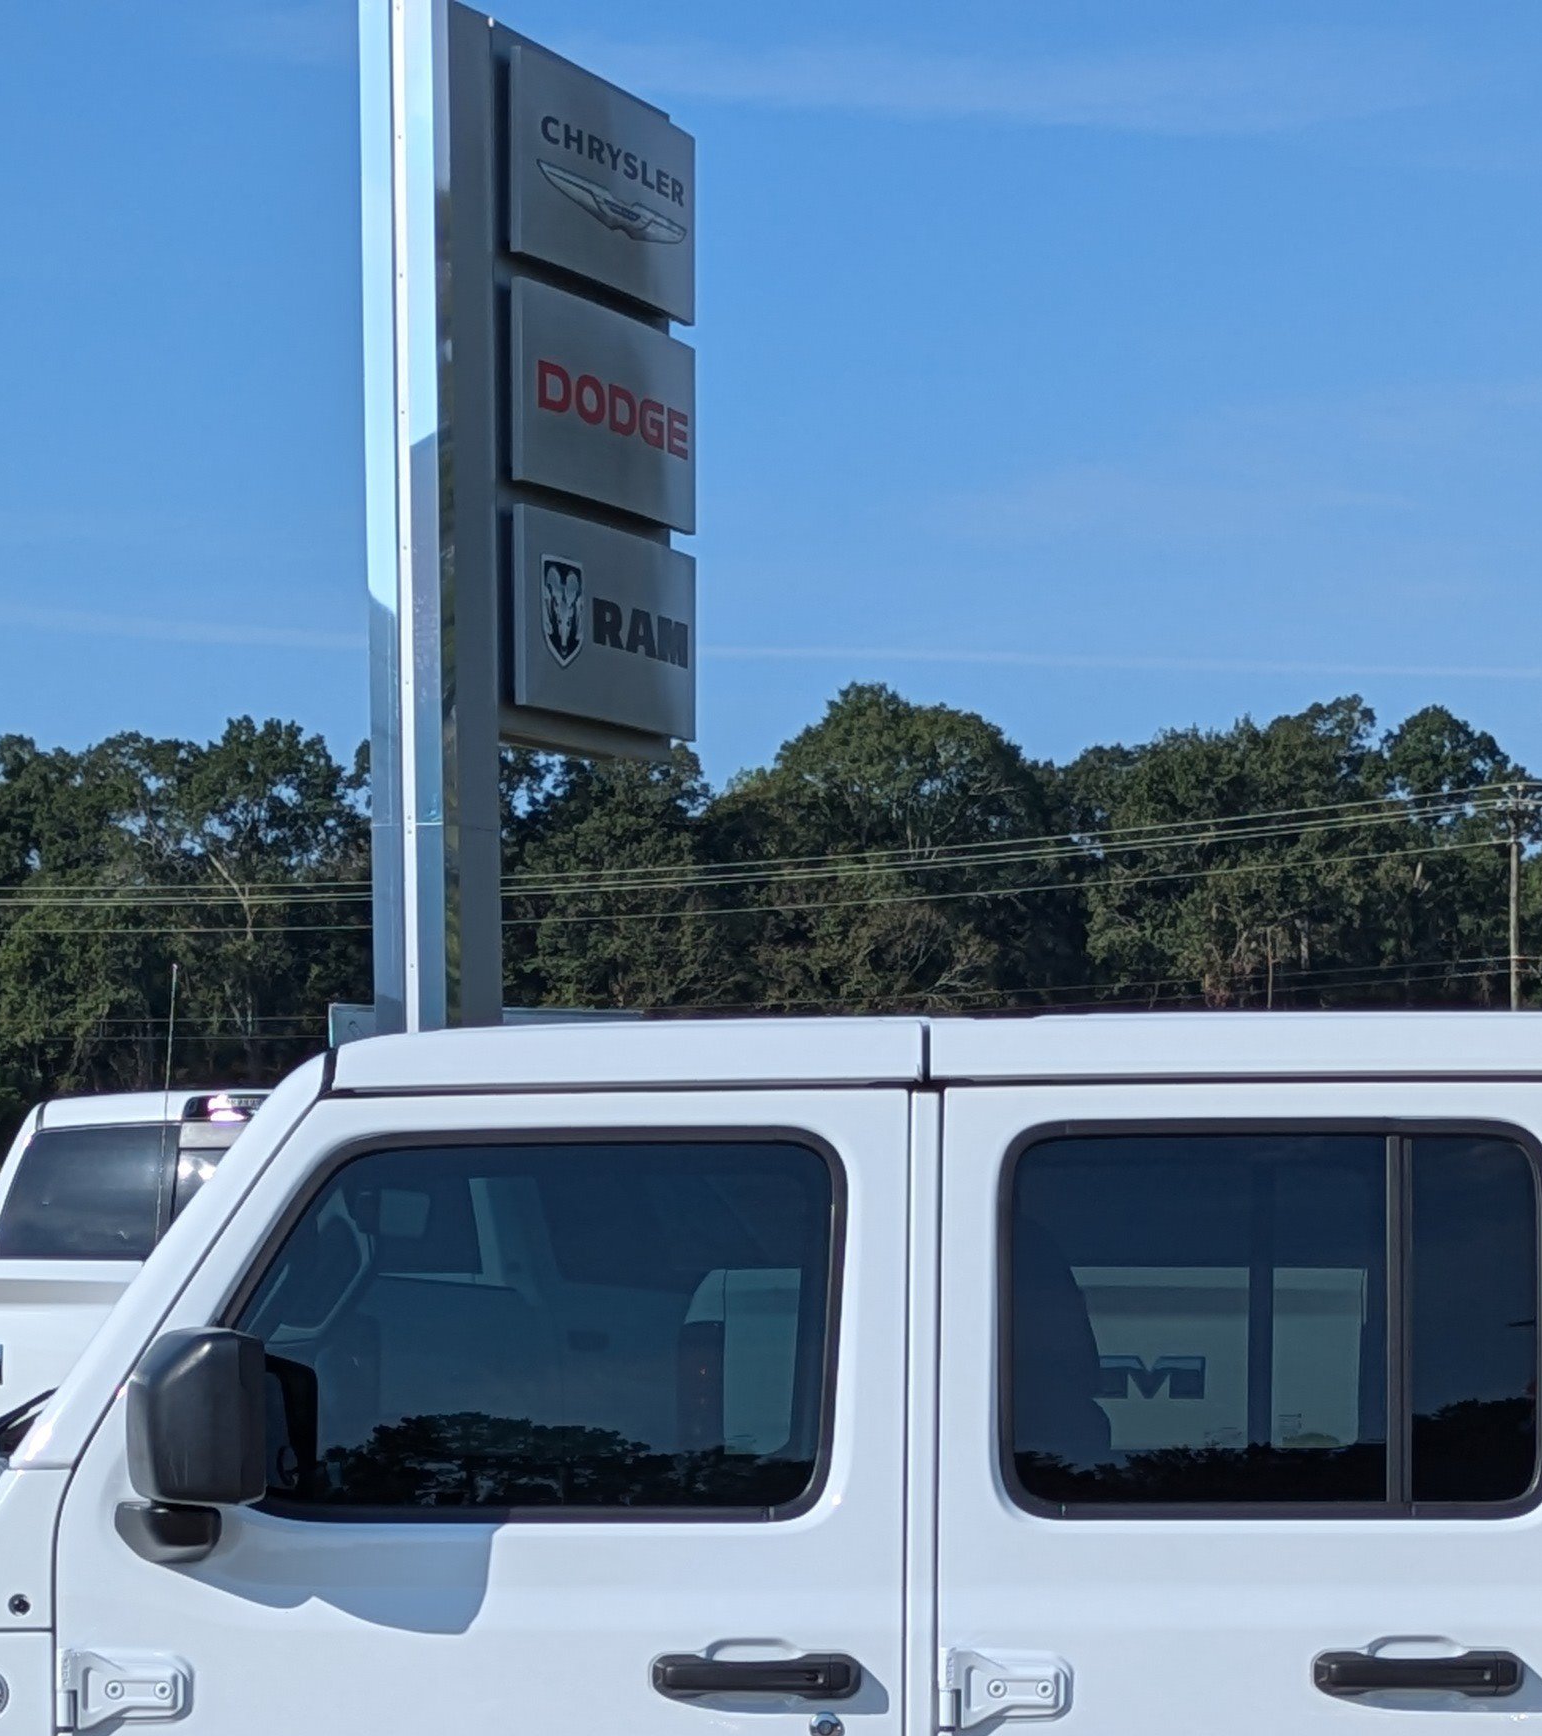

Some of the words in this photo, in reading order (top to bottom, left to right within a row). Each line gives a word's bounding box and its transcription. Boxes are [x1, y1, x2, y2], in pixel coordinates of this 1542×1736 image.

[540, 115, 685, 208] CHRYSLER
[537, 359, 689, 461] DODGE
[592, 597, 689, 669] RAM
